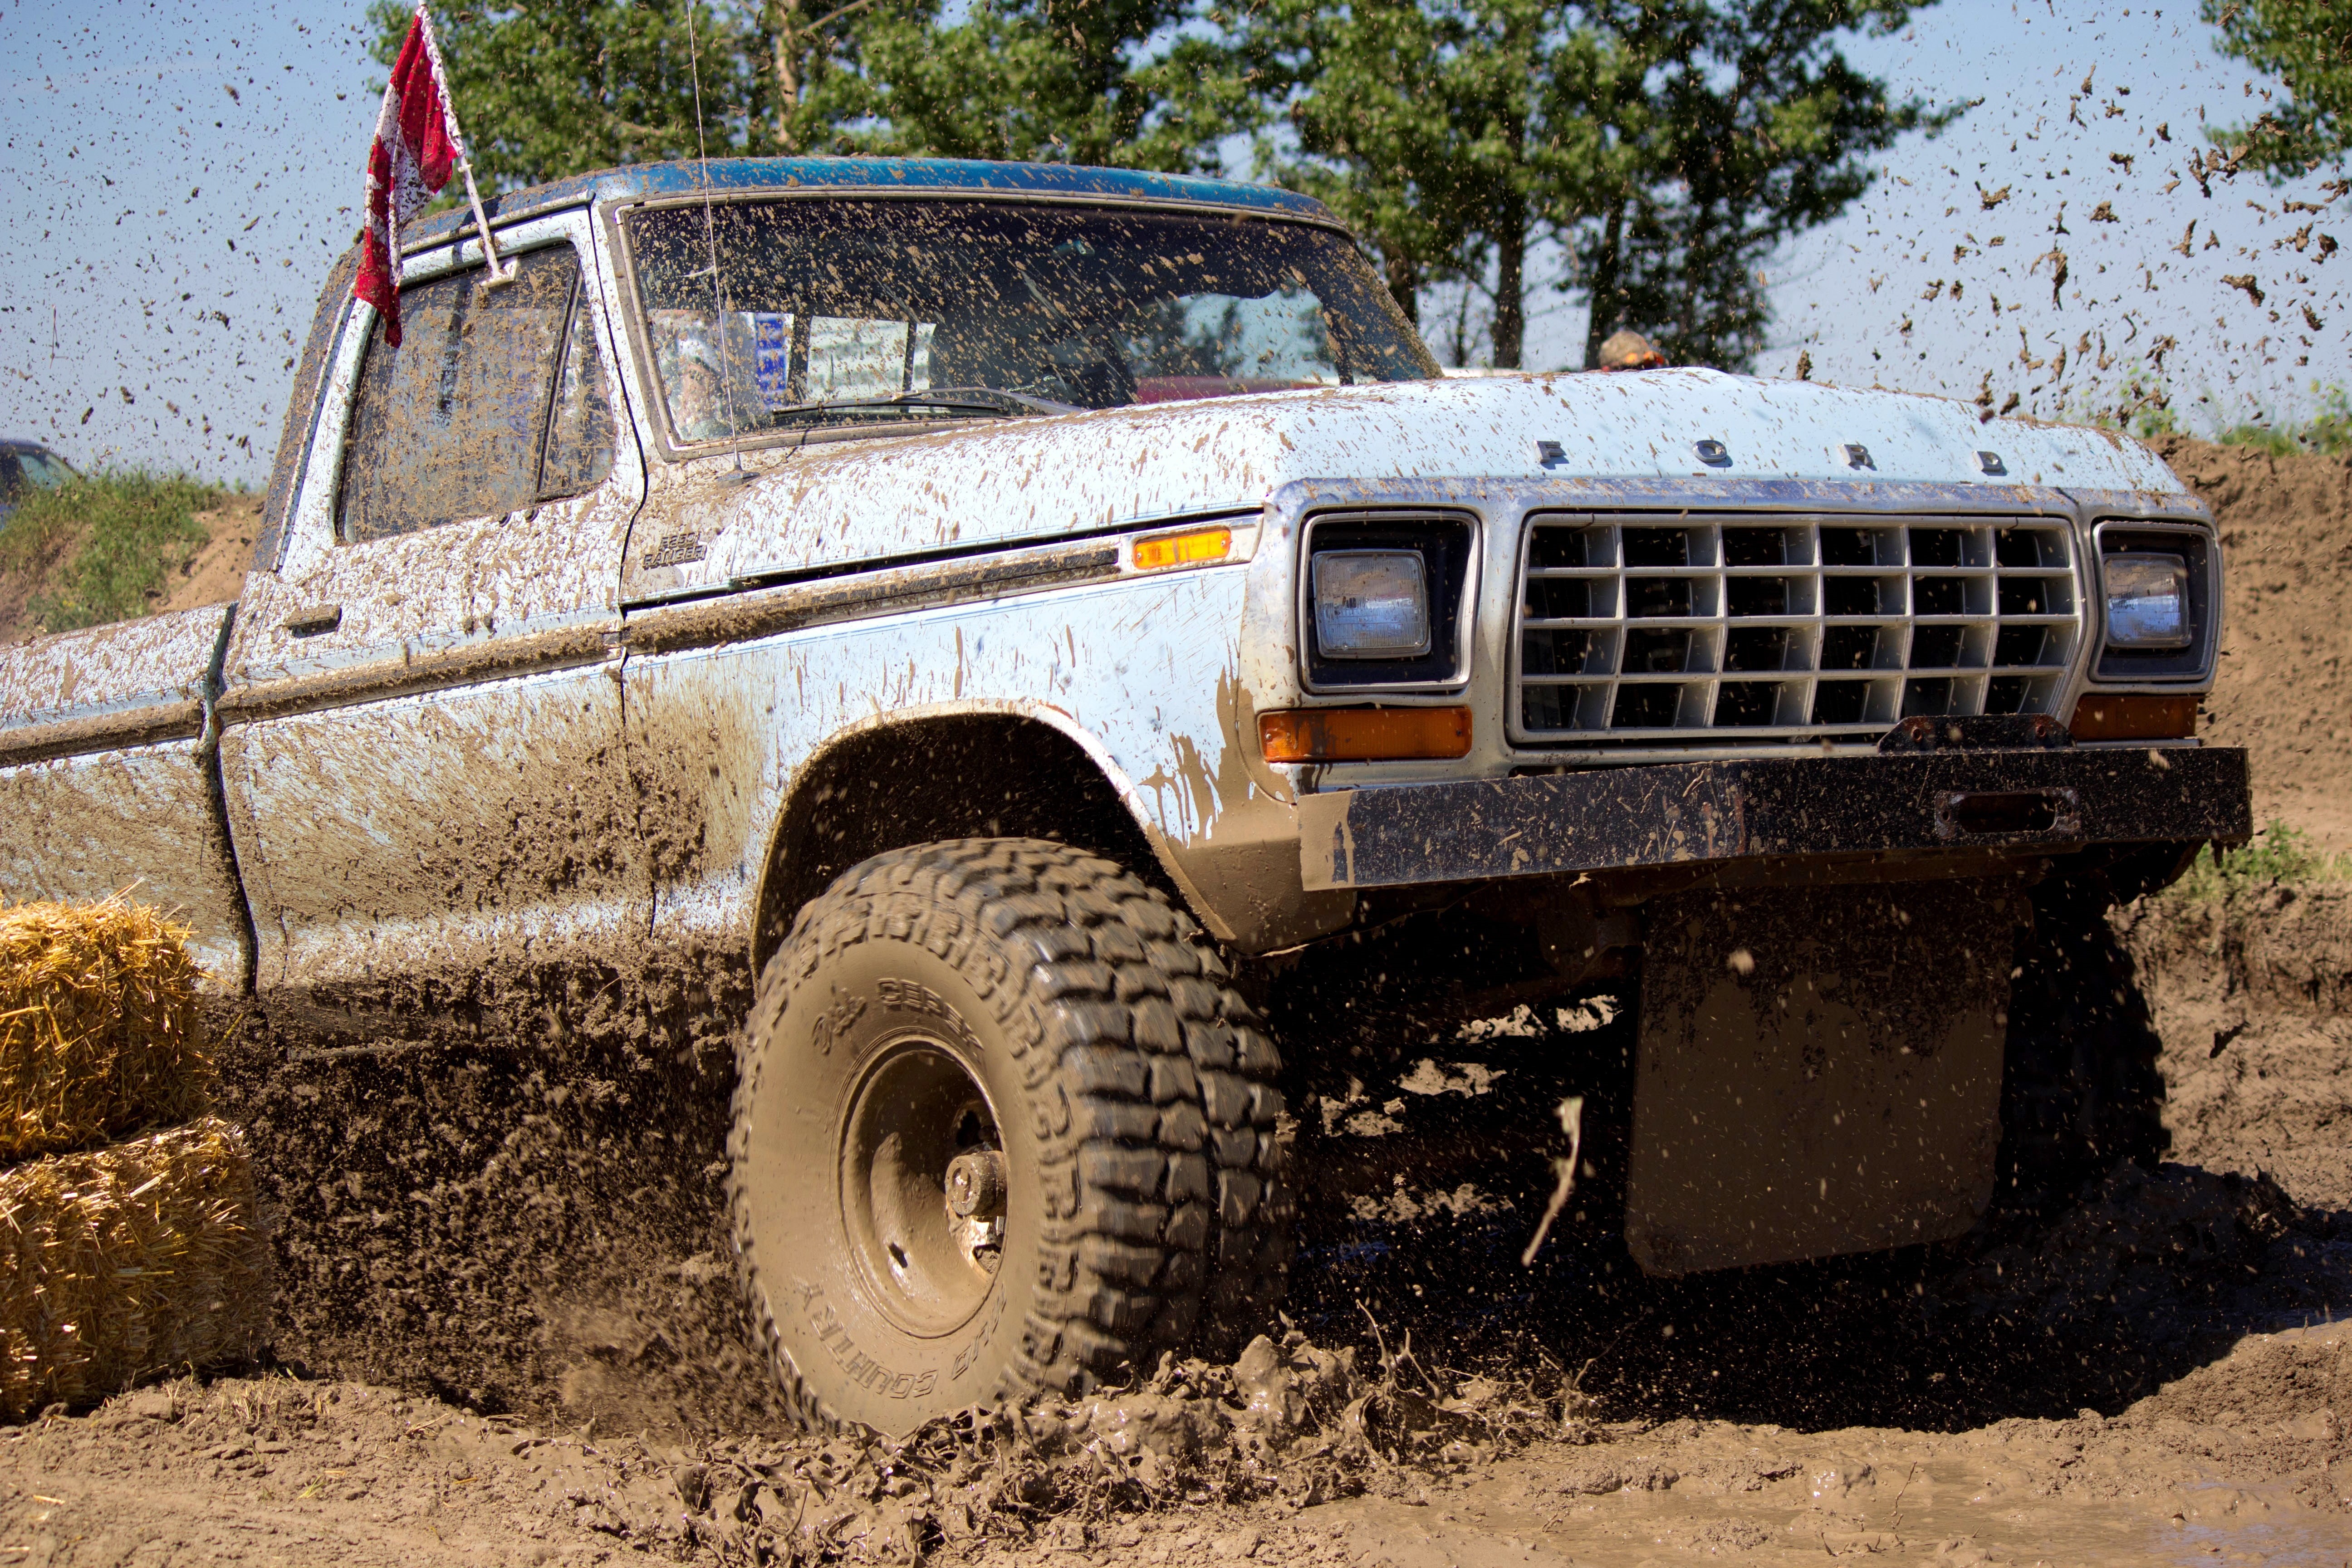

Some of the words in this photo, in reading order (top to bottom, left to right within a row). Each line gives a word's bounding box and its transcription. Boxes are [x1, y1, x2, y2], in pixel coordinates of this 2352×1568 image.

[1533, 439, 2003, 472] FORD
[643, 545, 706, 569] RANGER
[795, 1279, 938, 1399] COUNTRY
